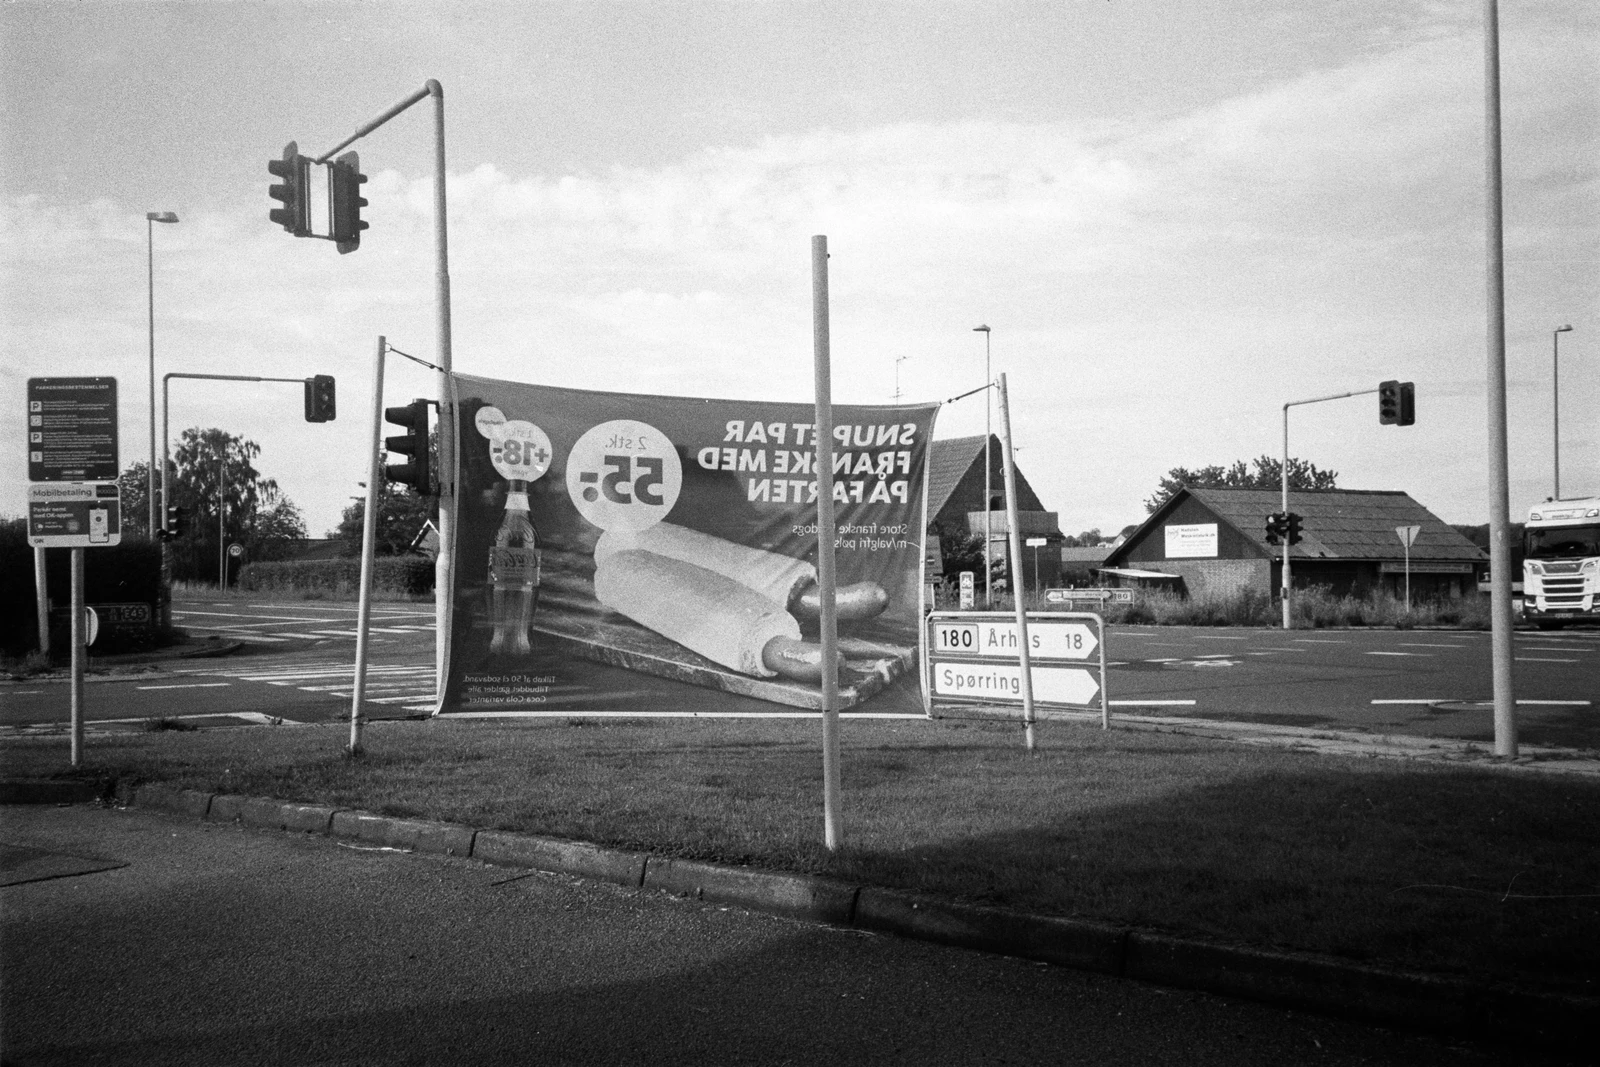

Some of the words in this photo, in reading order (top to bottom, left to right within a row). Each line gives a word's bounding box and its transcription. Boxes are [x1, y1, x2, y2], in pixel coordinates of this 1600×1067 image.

[32, 488, 93, 498] Mobilbetaling
[124, 608, 144, 619] E45
[941, 629, 973, 648] 180
[988, 627, 1041, 649] Århs
[1065, 633, 1083, 650] 18
[943, 669, 1020, 695] Spørring
